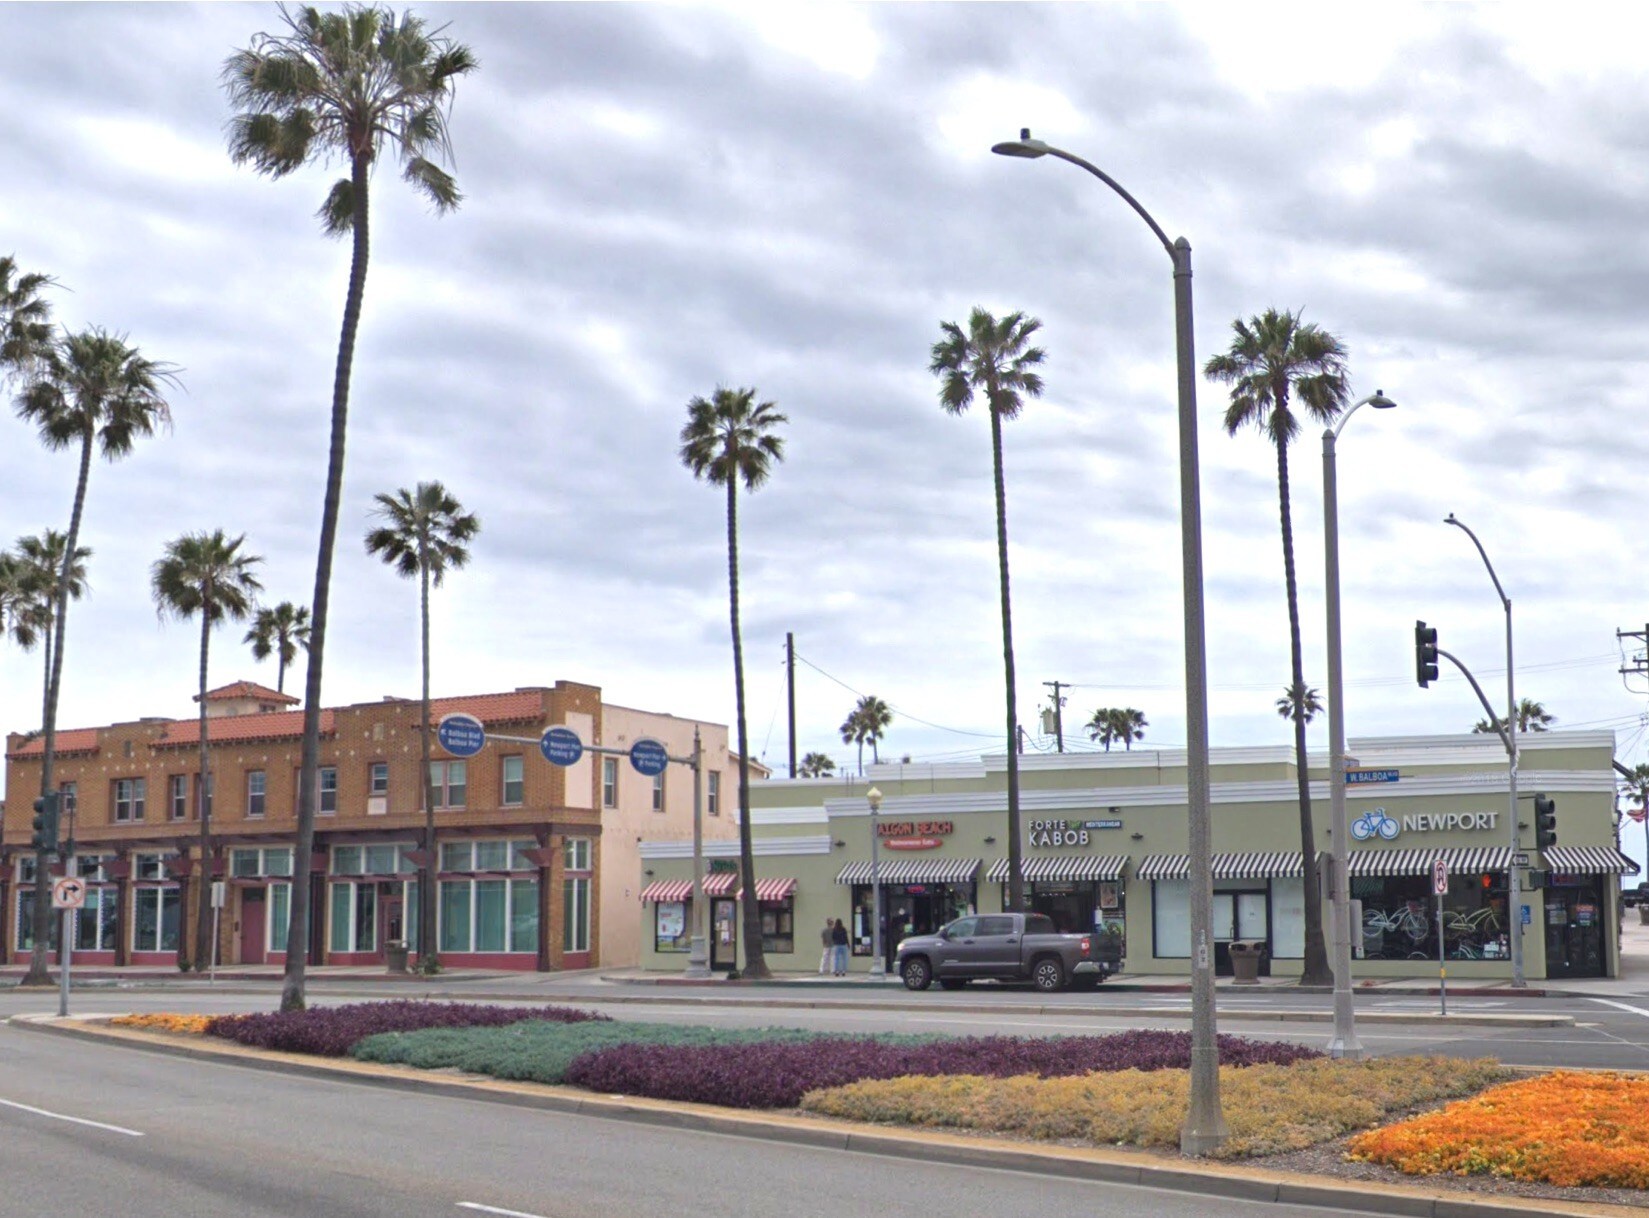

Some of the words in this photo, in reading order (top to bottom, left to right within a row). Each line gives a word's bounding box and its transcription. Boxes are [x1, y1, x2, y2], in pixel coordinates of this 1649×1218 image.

[1358, 771, 1388, 782] BALBOA
[877, 822, 914, 836] AIGON
[918, 820, 953, 835] BEACH
[1028, 820, 1067, 830] FORTE
[1403, 812, 1498, 831] NEWPORT
[1029, 830, 1089, 846] KABOB
